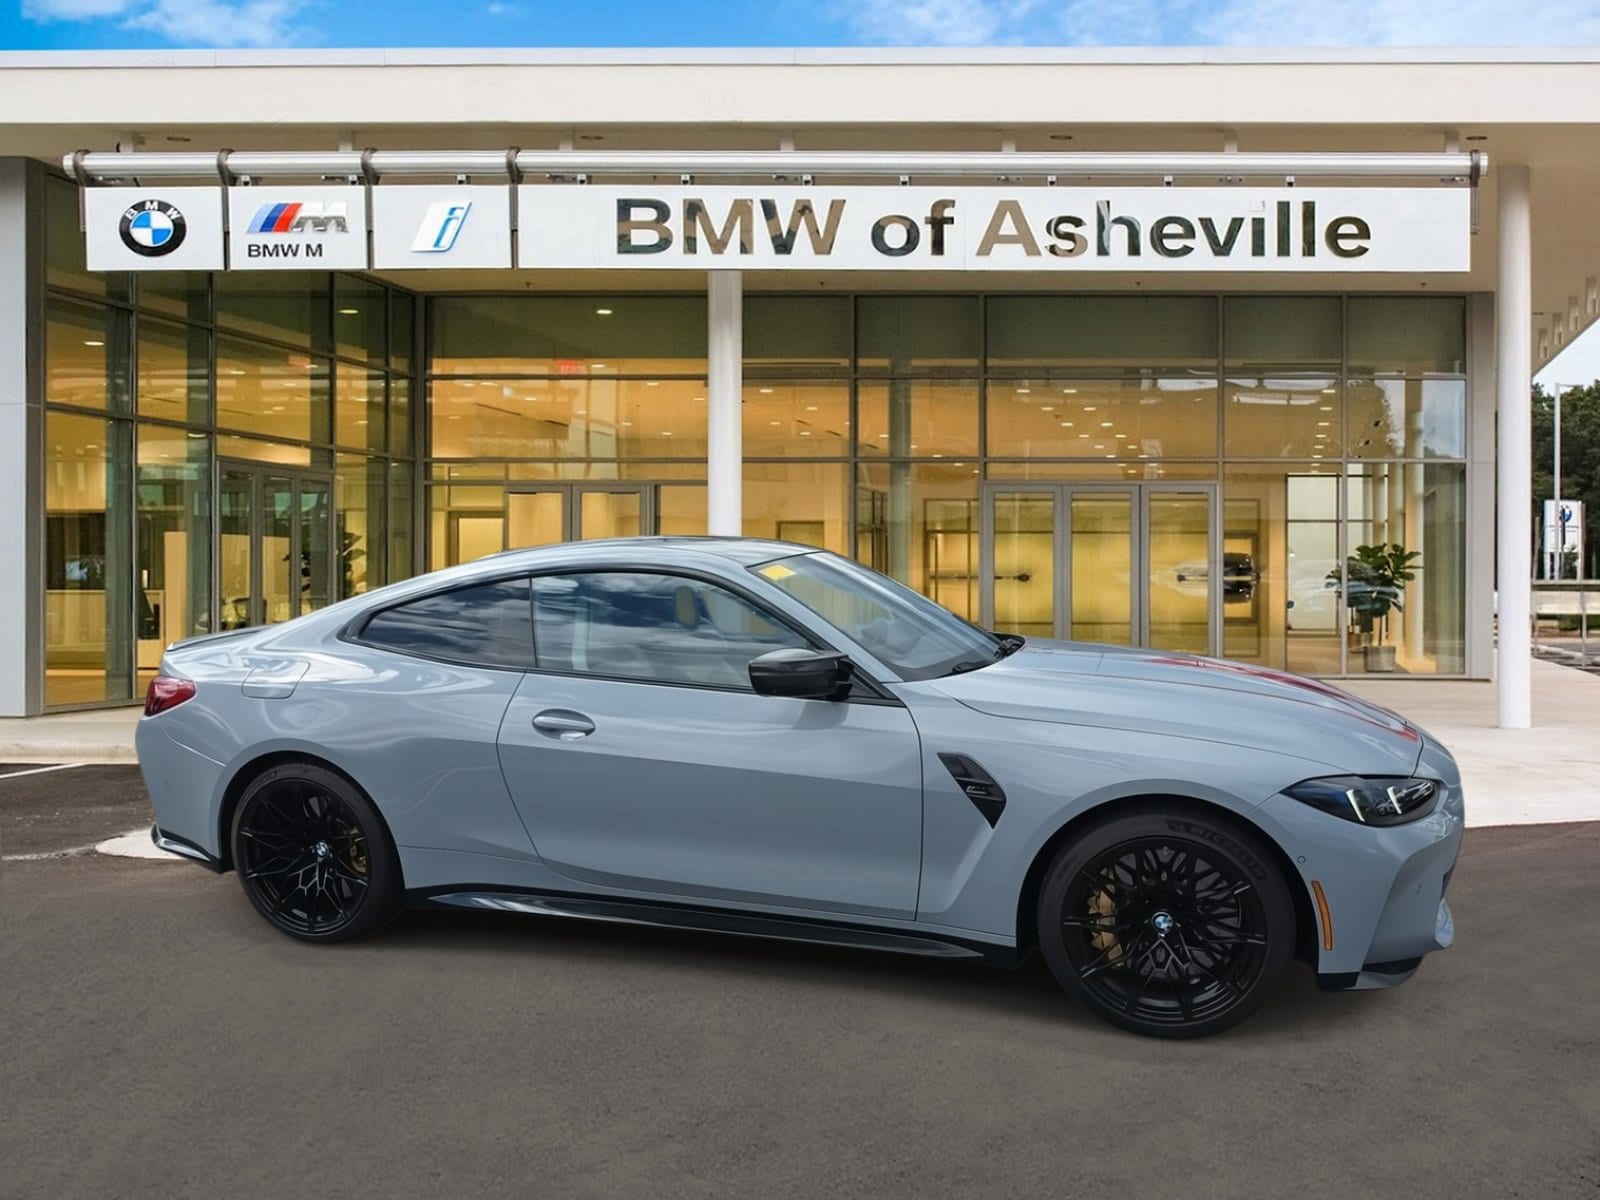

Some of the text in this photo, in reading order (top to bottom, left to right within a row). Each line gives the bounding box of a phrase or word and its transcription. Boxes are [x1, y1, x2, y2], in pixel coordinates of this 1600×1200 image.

[125, 200, 181, 221] BMW
[616, 198, 1372, 258] BMW of Asheville
[247, 243, 323, 258] BMW M
